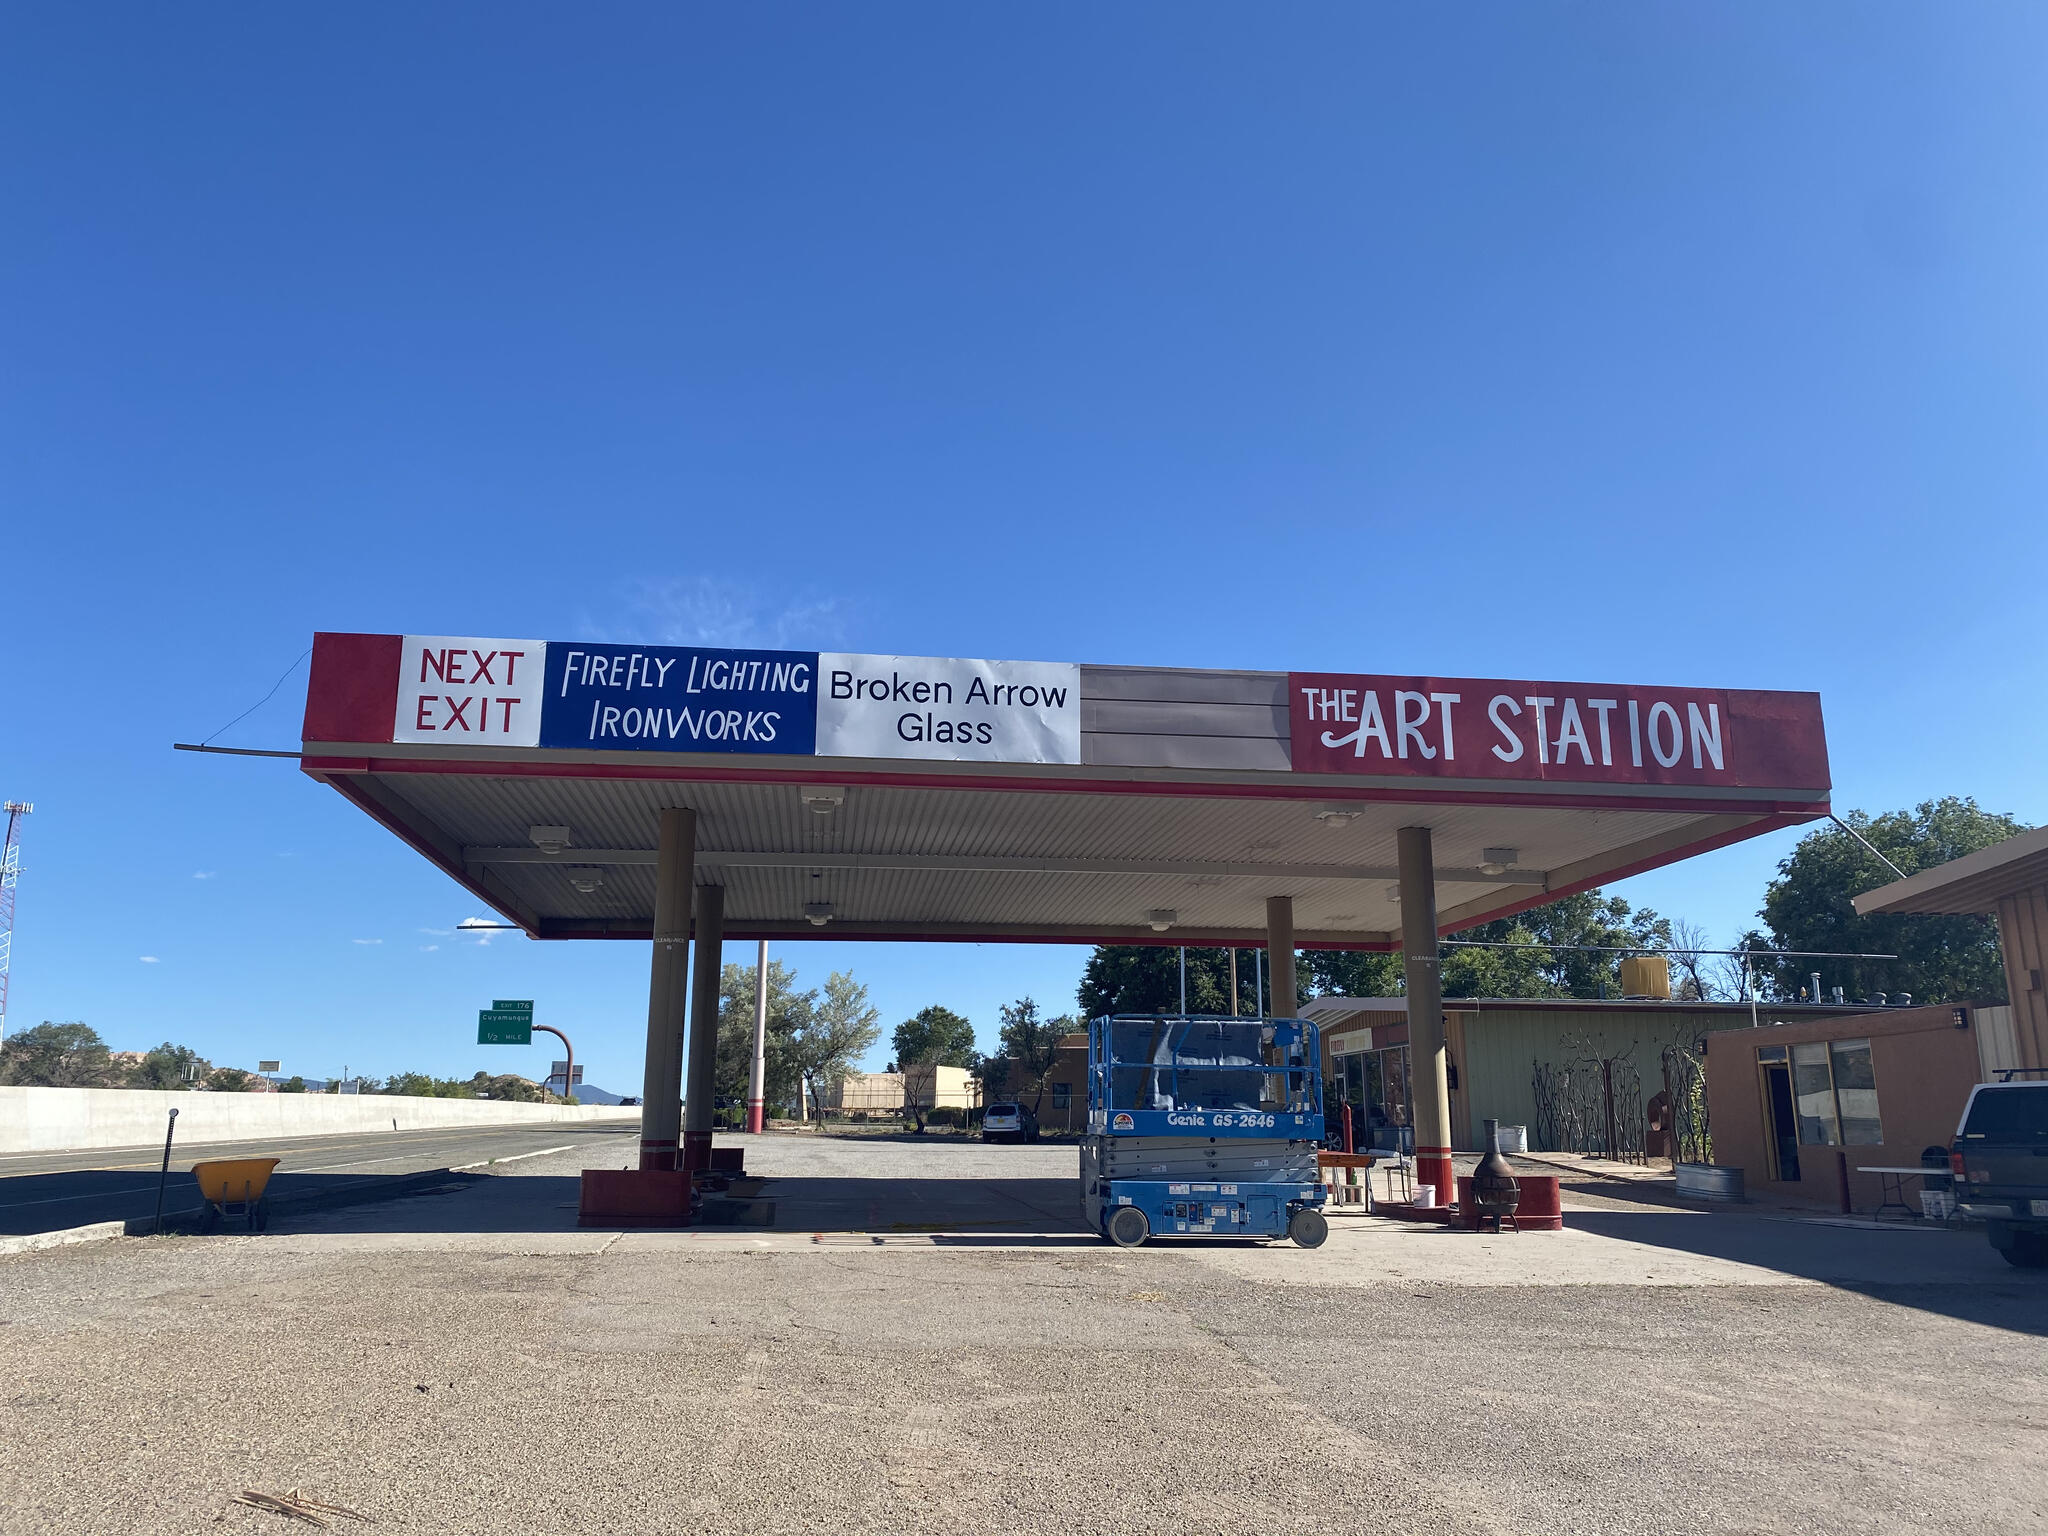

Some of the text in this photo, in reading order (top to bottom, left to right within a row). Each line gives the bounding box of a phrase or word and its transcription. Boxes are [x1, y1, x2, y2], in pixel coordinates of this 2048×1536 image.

[420, 648, 525, 686] NEXT
[561, 651, 810, 697] FIREFLY LIGHTING
[831, 670, 1067, 708] Broken Arrow
[415, 695, 521, 733] EXIT
[897, 712, 993, 744] Glass
[1301, 688, 1725, 770] THE ART STATION
[487, 1032, 498, 1041] 1/2
[1167, 1112, 1275, 1128] Genie GS-2646
